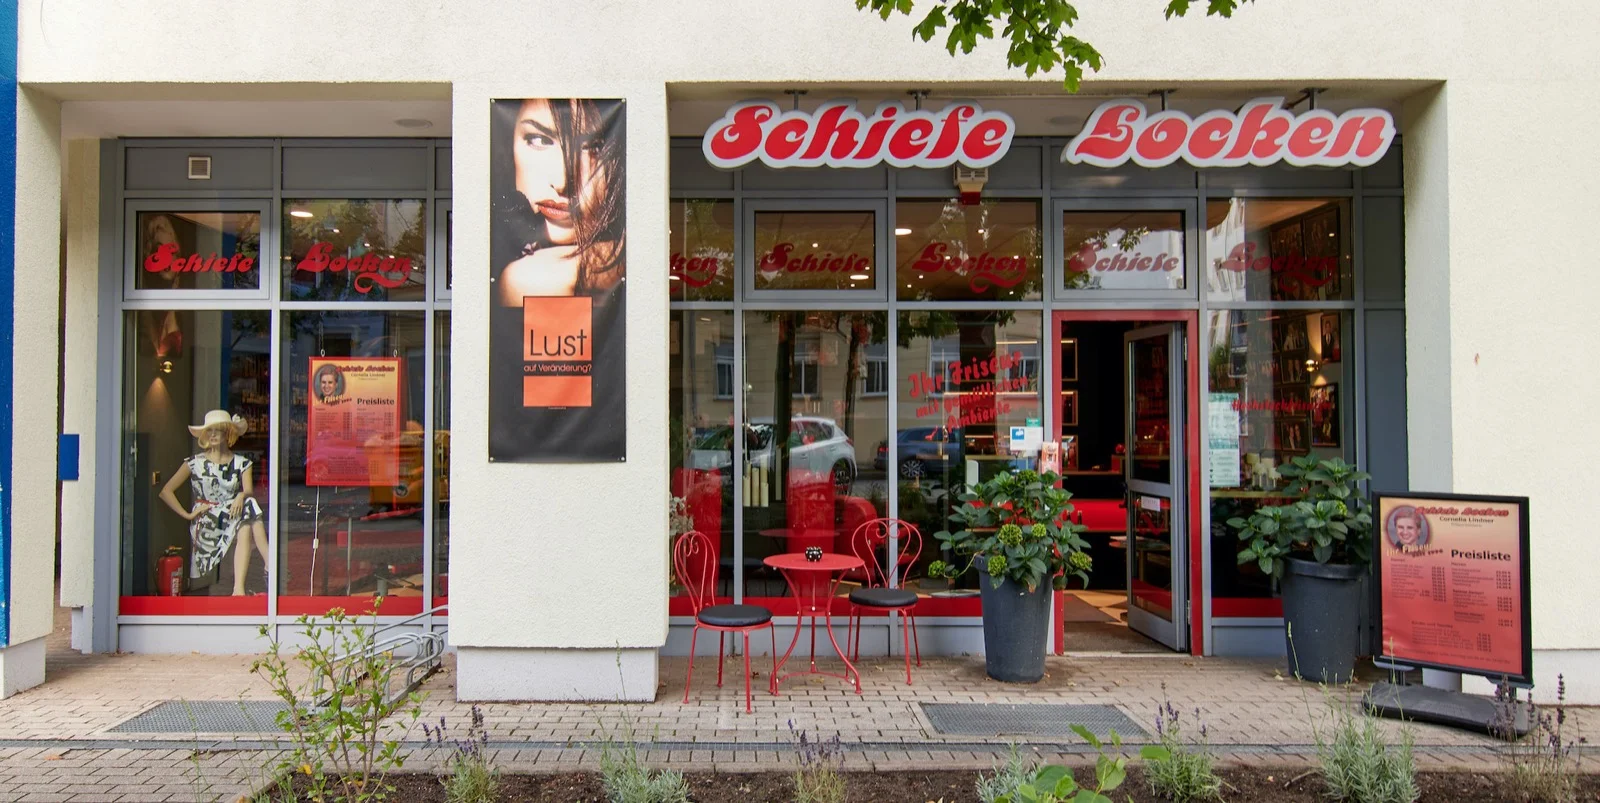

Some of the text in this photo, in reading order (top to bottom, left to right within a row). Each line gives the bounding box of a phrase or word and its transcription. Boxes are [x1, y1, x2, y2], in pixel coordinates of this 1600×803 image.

[710, 103, 1386, 160] Schiefe Locken
[144, 241, 412, 293] Schiefe Locken
[759, 242, 1028, 294] Schiefe Locken
[1068, 241, 1338, 292] Schiefe Locken
[530, 328, 588, 357] Lust
[523, 363, 593, 373] auf Veränderung?
[908, 351, 1021, 399] Ihr Friseur
[356, 397, 395, 406] Preisliste
[916, 399, 939, 418] mit
[947, 402, 1012, 433] Ambiente
[1451, 549, 1511, 562] Preisliste
